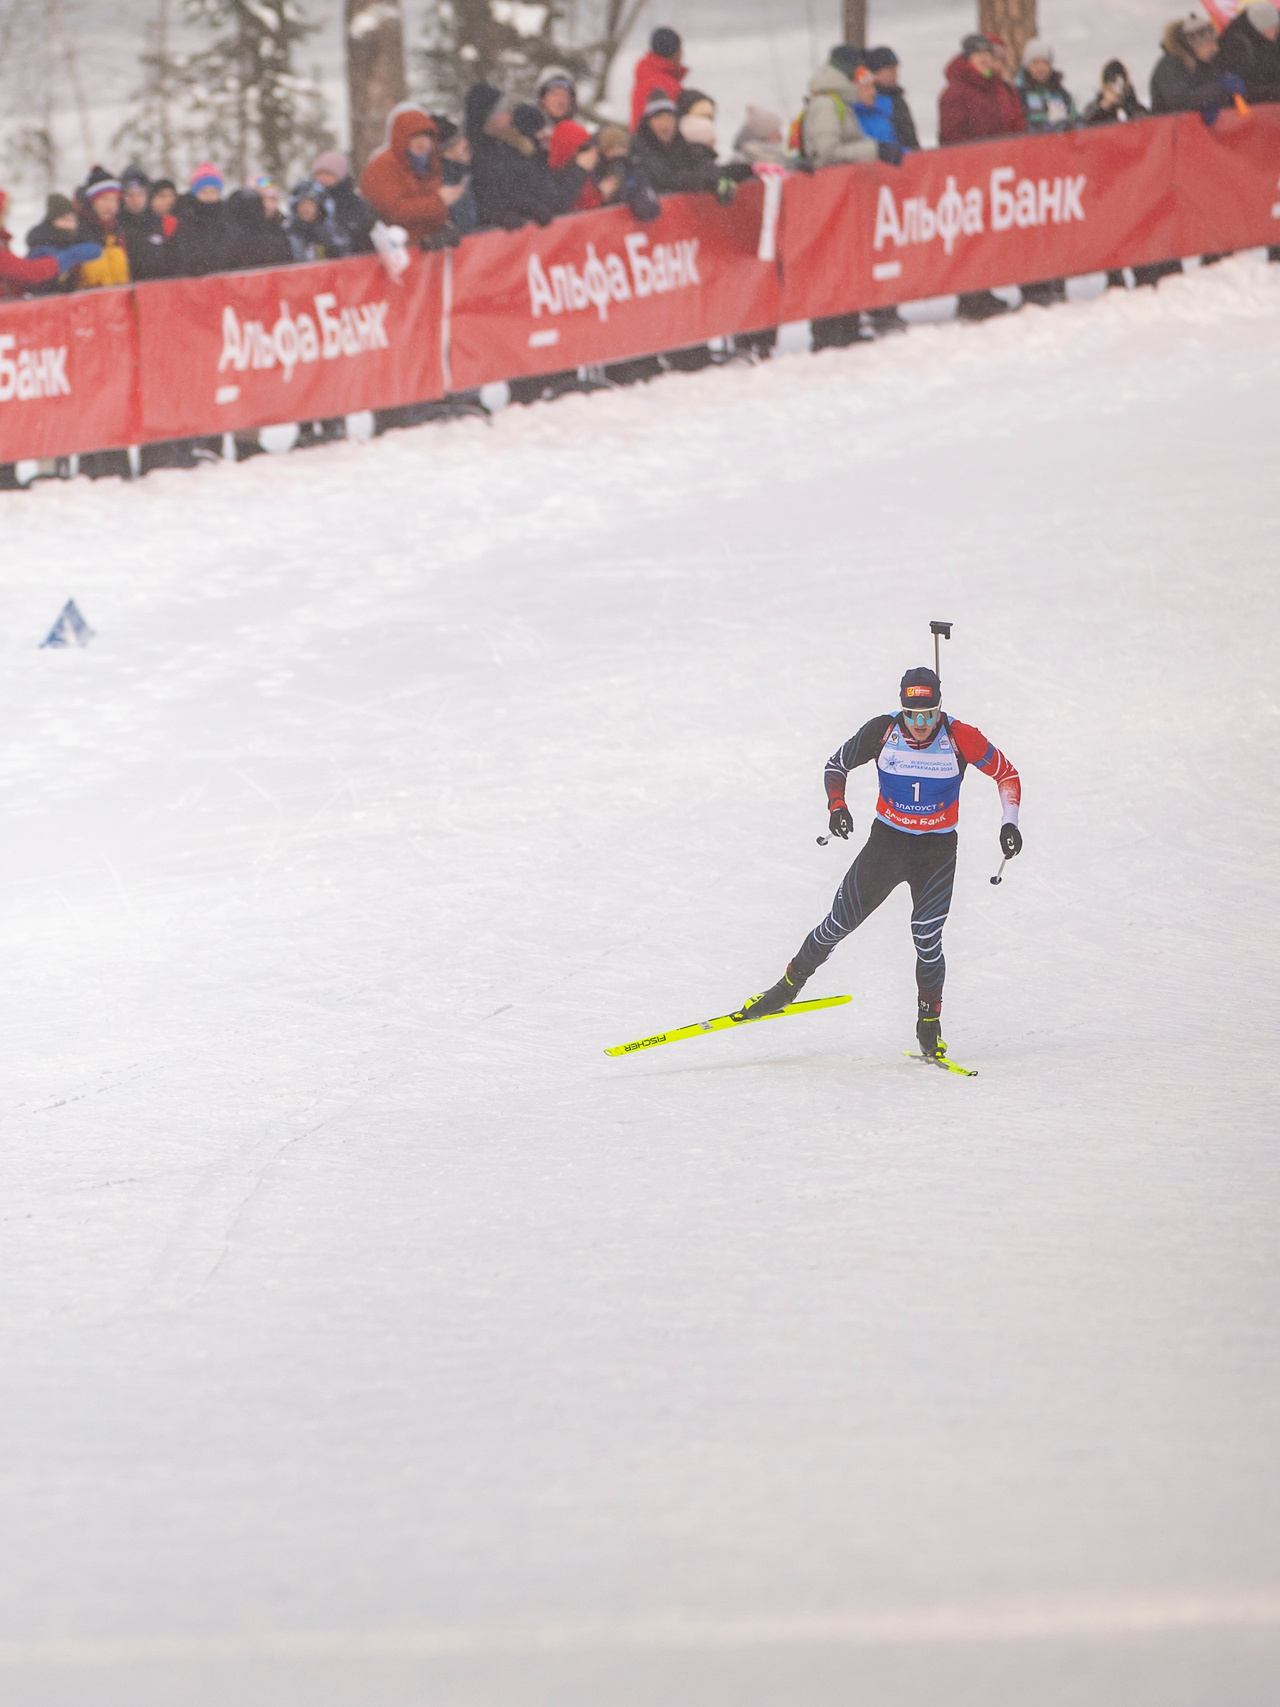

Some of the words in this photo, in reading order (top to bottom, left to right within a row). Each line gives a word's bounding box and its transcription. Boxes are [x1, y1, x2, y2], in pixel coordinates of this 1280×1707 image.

[873, 175, 986, 254] Альфа
[990, 167, 1086, 230] Банк
[527, 242, 628, 323] Альфа
[627, 233, 701, 297] Банк
[217, 300, 317, 382] Альфа
[314, 293, 390, 358] Банк
[899, 763, 939, 771] СПАРТАКИАДА
[910, 781, 921, 803] 1
[894, 803, 937, 811] ЗЛАТОУСТ
[624, 1034, 667, 1052] FISCHER
